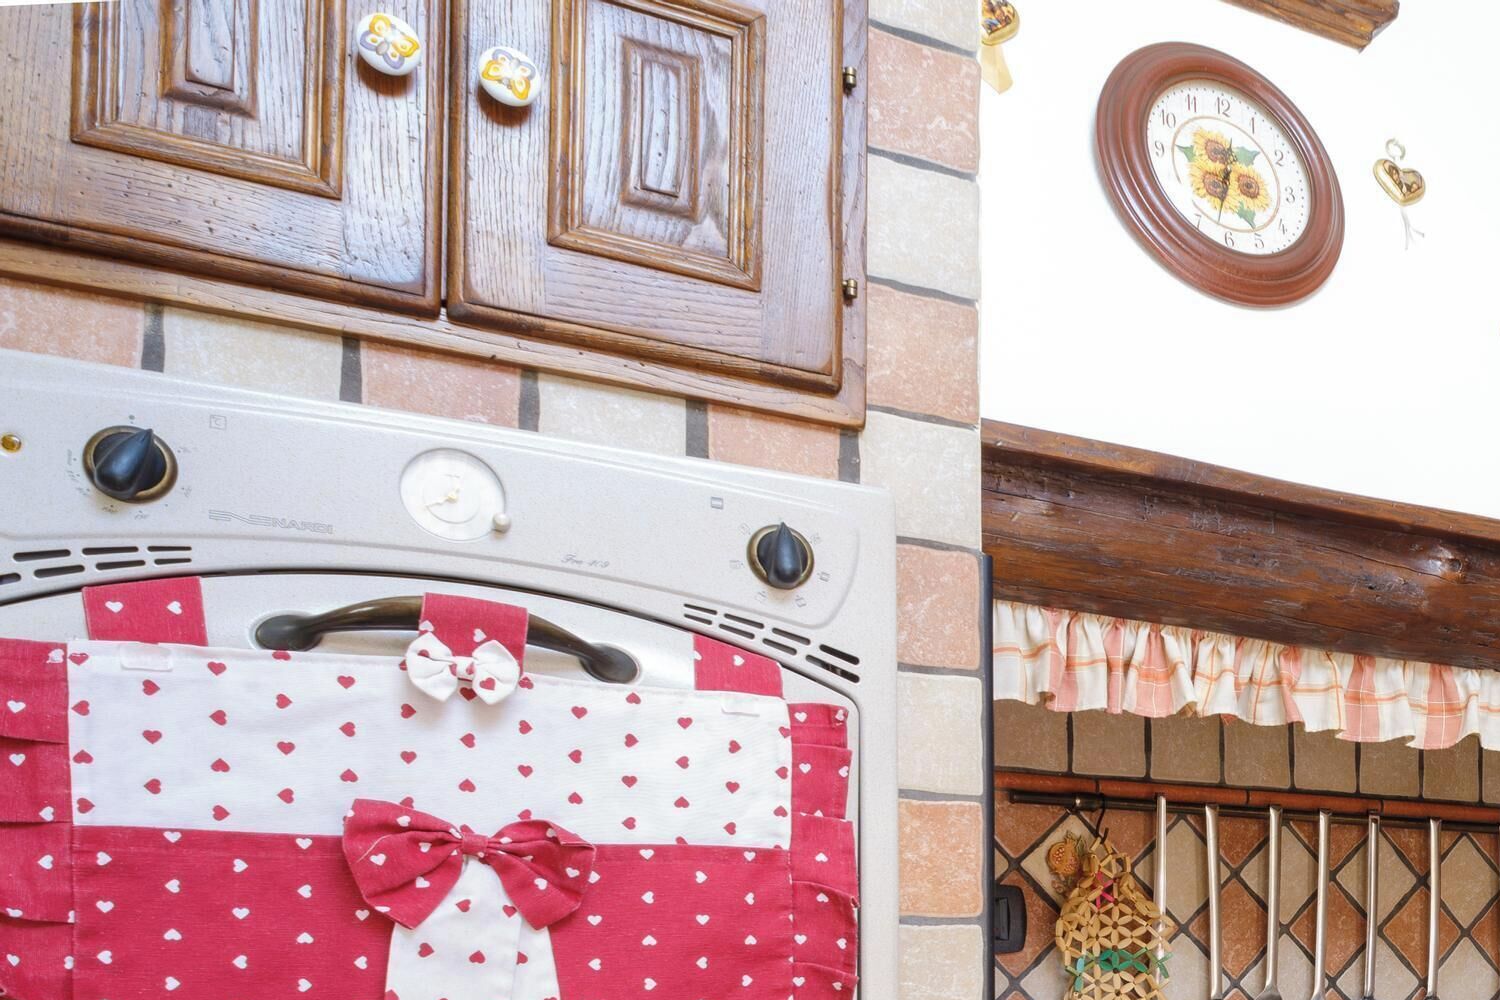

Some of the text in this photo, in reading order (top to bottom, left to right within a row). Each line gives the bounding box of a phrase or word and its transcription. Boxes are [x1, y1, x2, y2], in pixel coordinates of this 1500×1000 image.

[1185, 93, 1197, 113] 11
[1215, 96, 1231, 118] 12
[1160, 108, 1176, 129] 10
[1154, 140, 1165, 158] 9
[1274, 149, 1285, 167] 2
[1285, 186, 1296, 204] 3
[1194, 213, 1202, 230] 7
[1278, 217, 1288, 236] 4
[1224, 231, 1235, 248] 6
[1254, 232, 1265, 250] 5
[271, 517, 334, 535] NARDI
